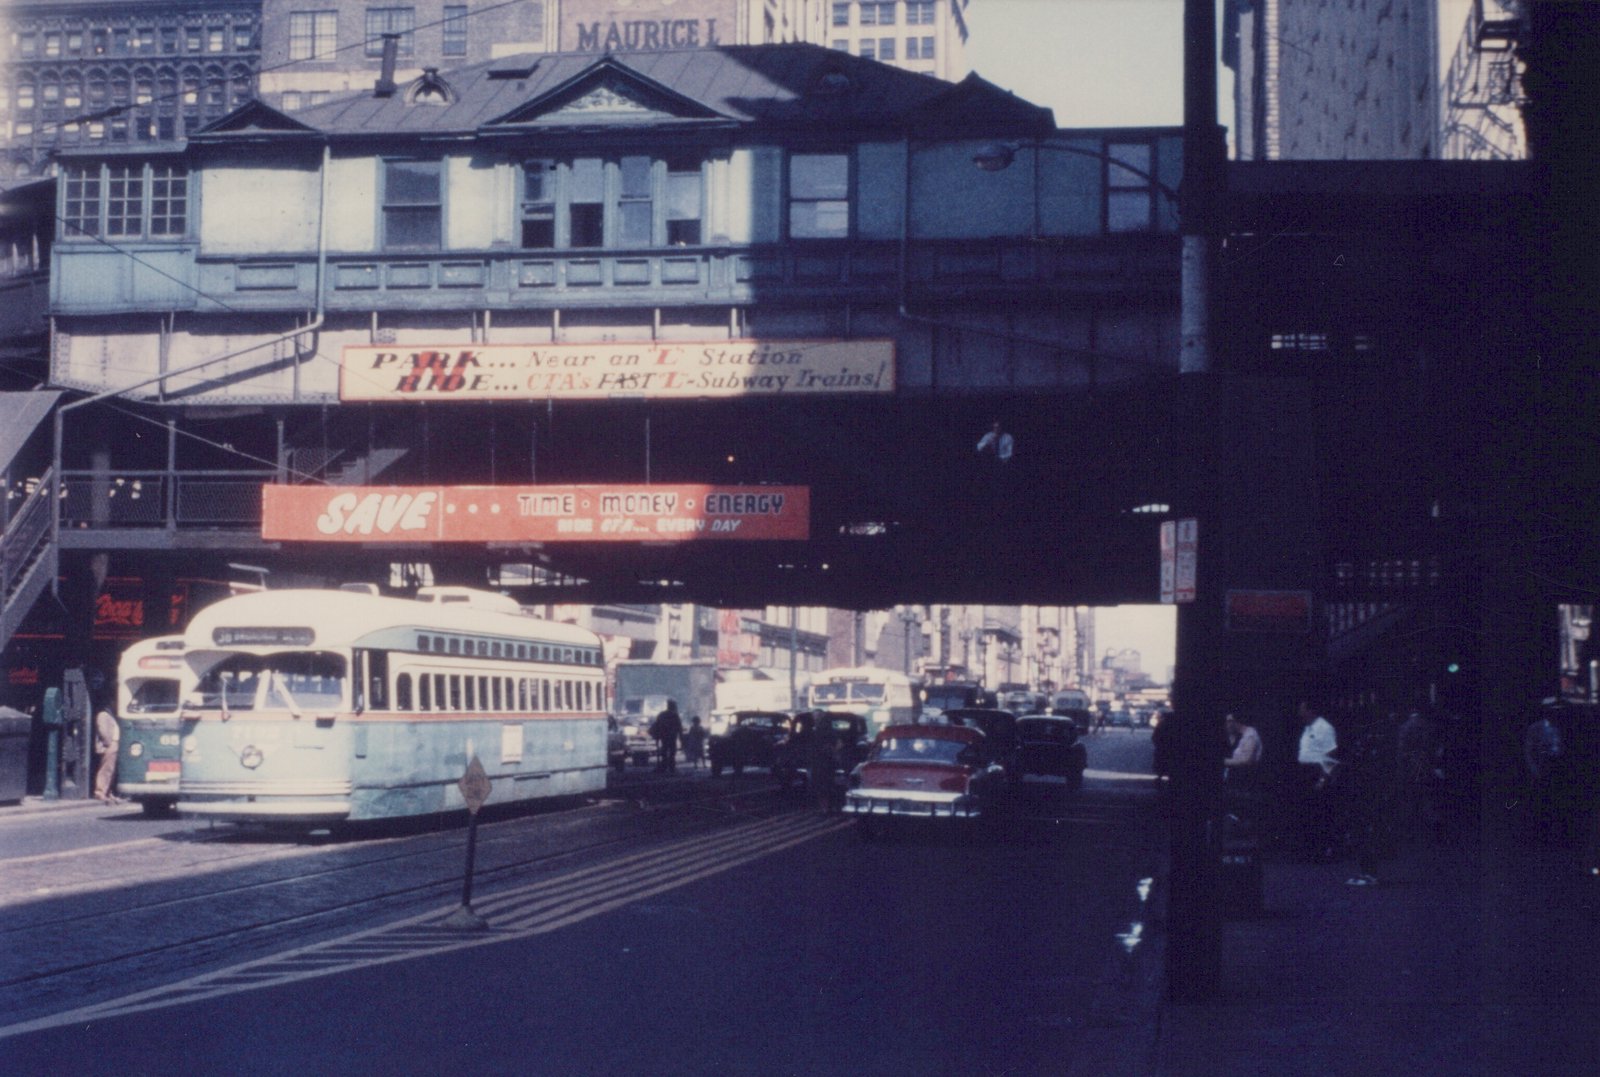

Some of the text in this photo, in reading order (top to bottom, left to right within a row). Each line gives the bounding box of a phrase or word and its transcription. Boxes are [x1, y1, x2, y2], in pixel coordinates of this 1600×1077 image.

[576, 18, 699, 52] MAURICE
[525, 351, 596, 368] Near
[609, 353, 640, 366] an
[700, 345, 803, 366] Station
[527, 372, 592, 390] CTA's
[596, 372, 657, 389] FAST
[797, 360, 886, 389] Trains!
[316, 491, 785, 535] SAVE TIME MONEY ENERGY
[656, 518, 705, 532] EVERY
[711, 518, 742, 532] DAY
